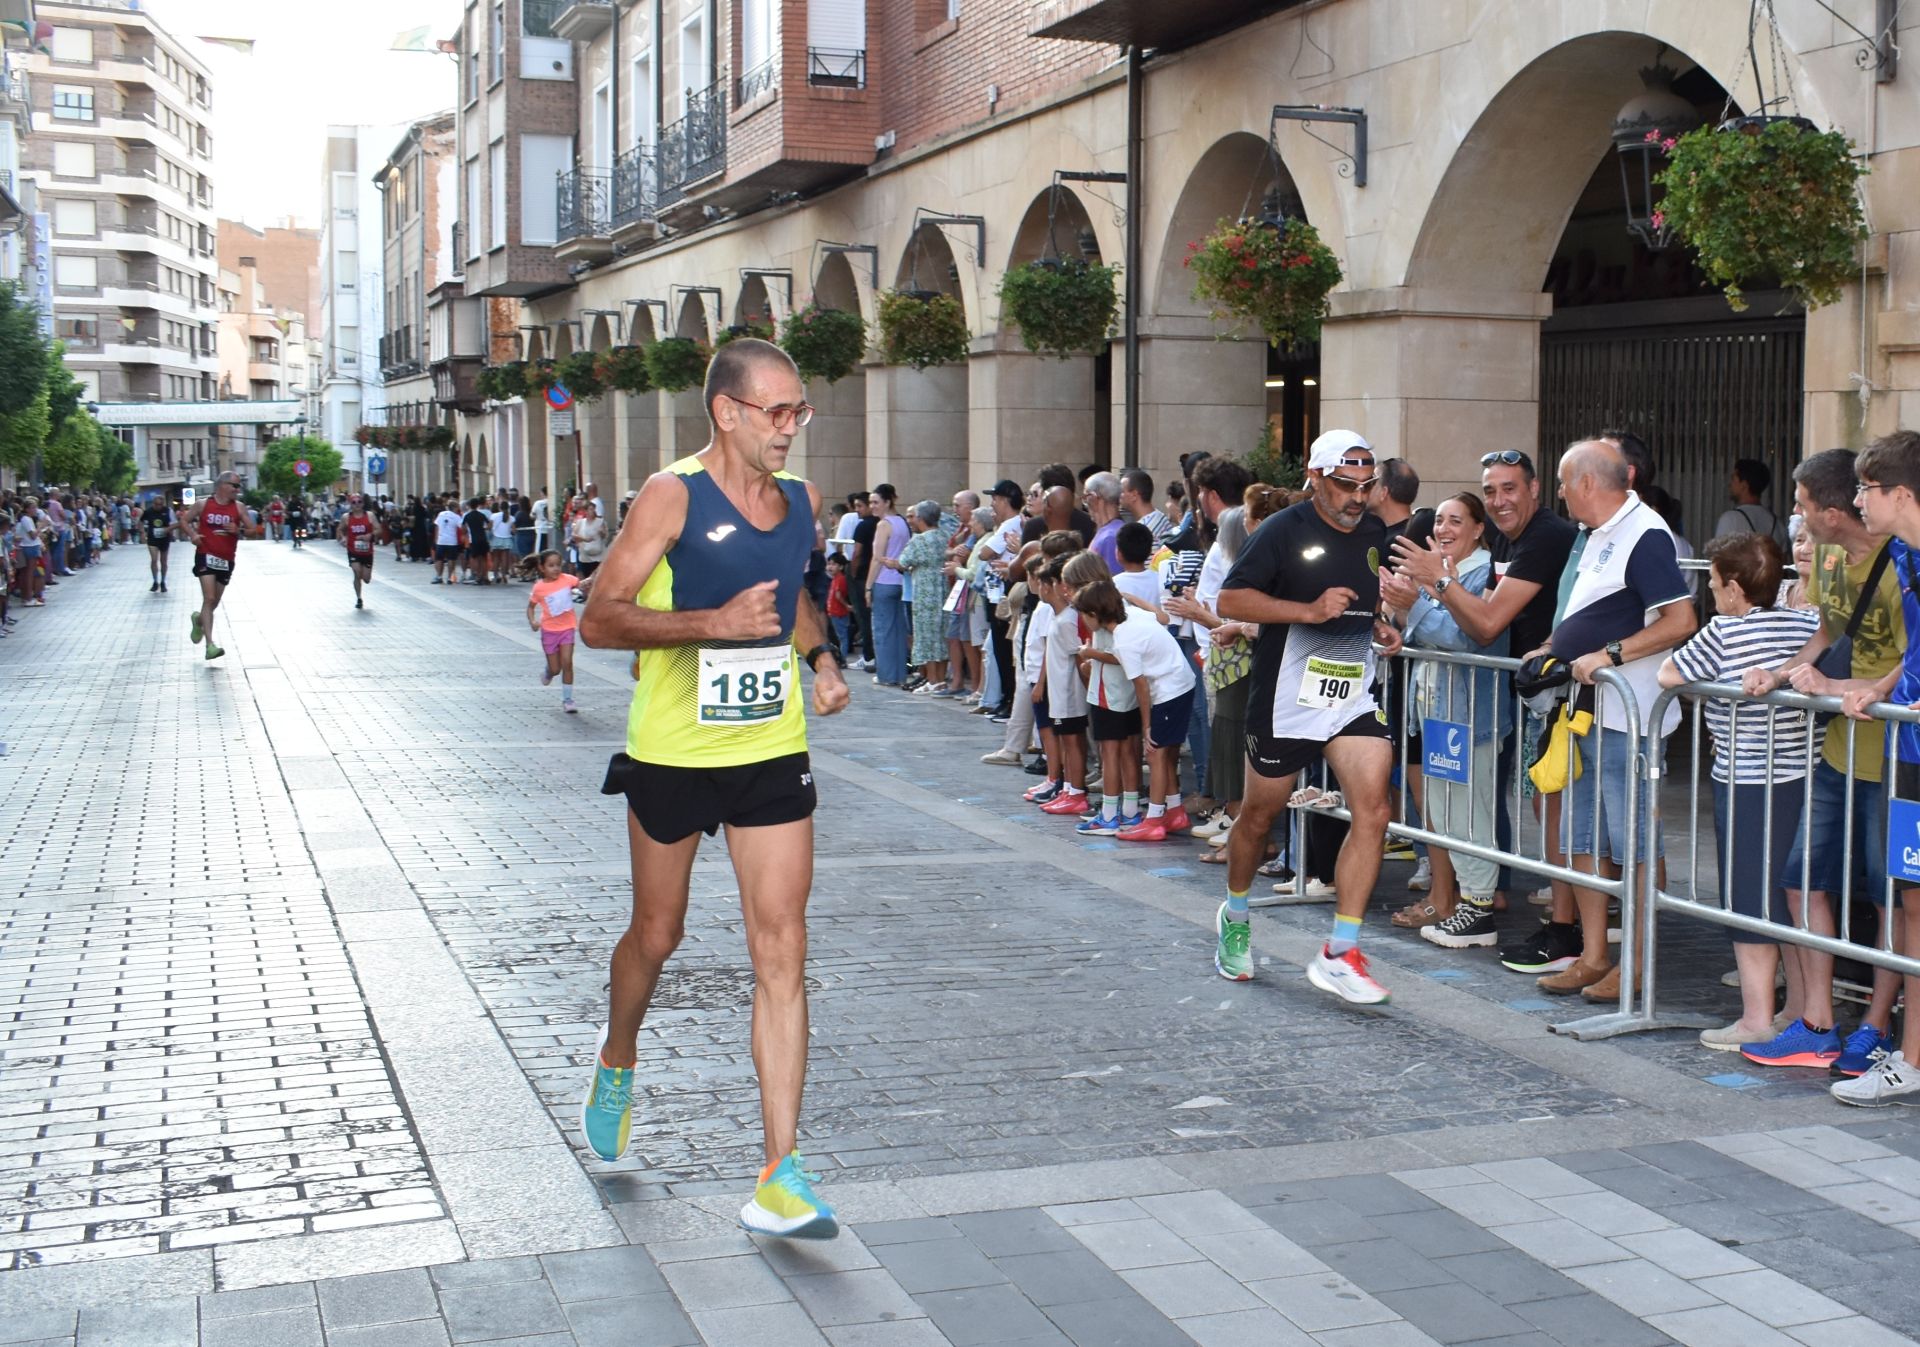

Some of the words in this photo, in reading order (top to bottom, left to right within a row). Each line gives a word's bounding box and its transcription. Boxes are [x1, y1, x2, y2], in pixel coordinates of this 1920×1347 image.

[207, 513, 231, 525] 360
[711, 670, 782, 704] 185
[1319, 678, 1350, 700] 190
[1429, 752, 1461, 771] Calahorra
